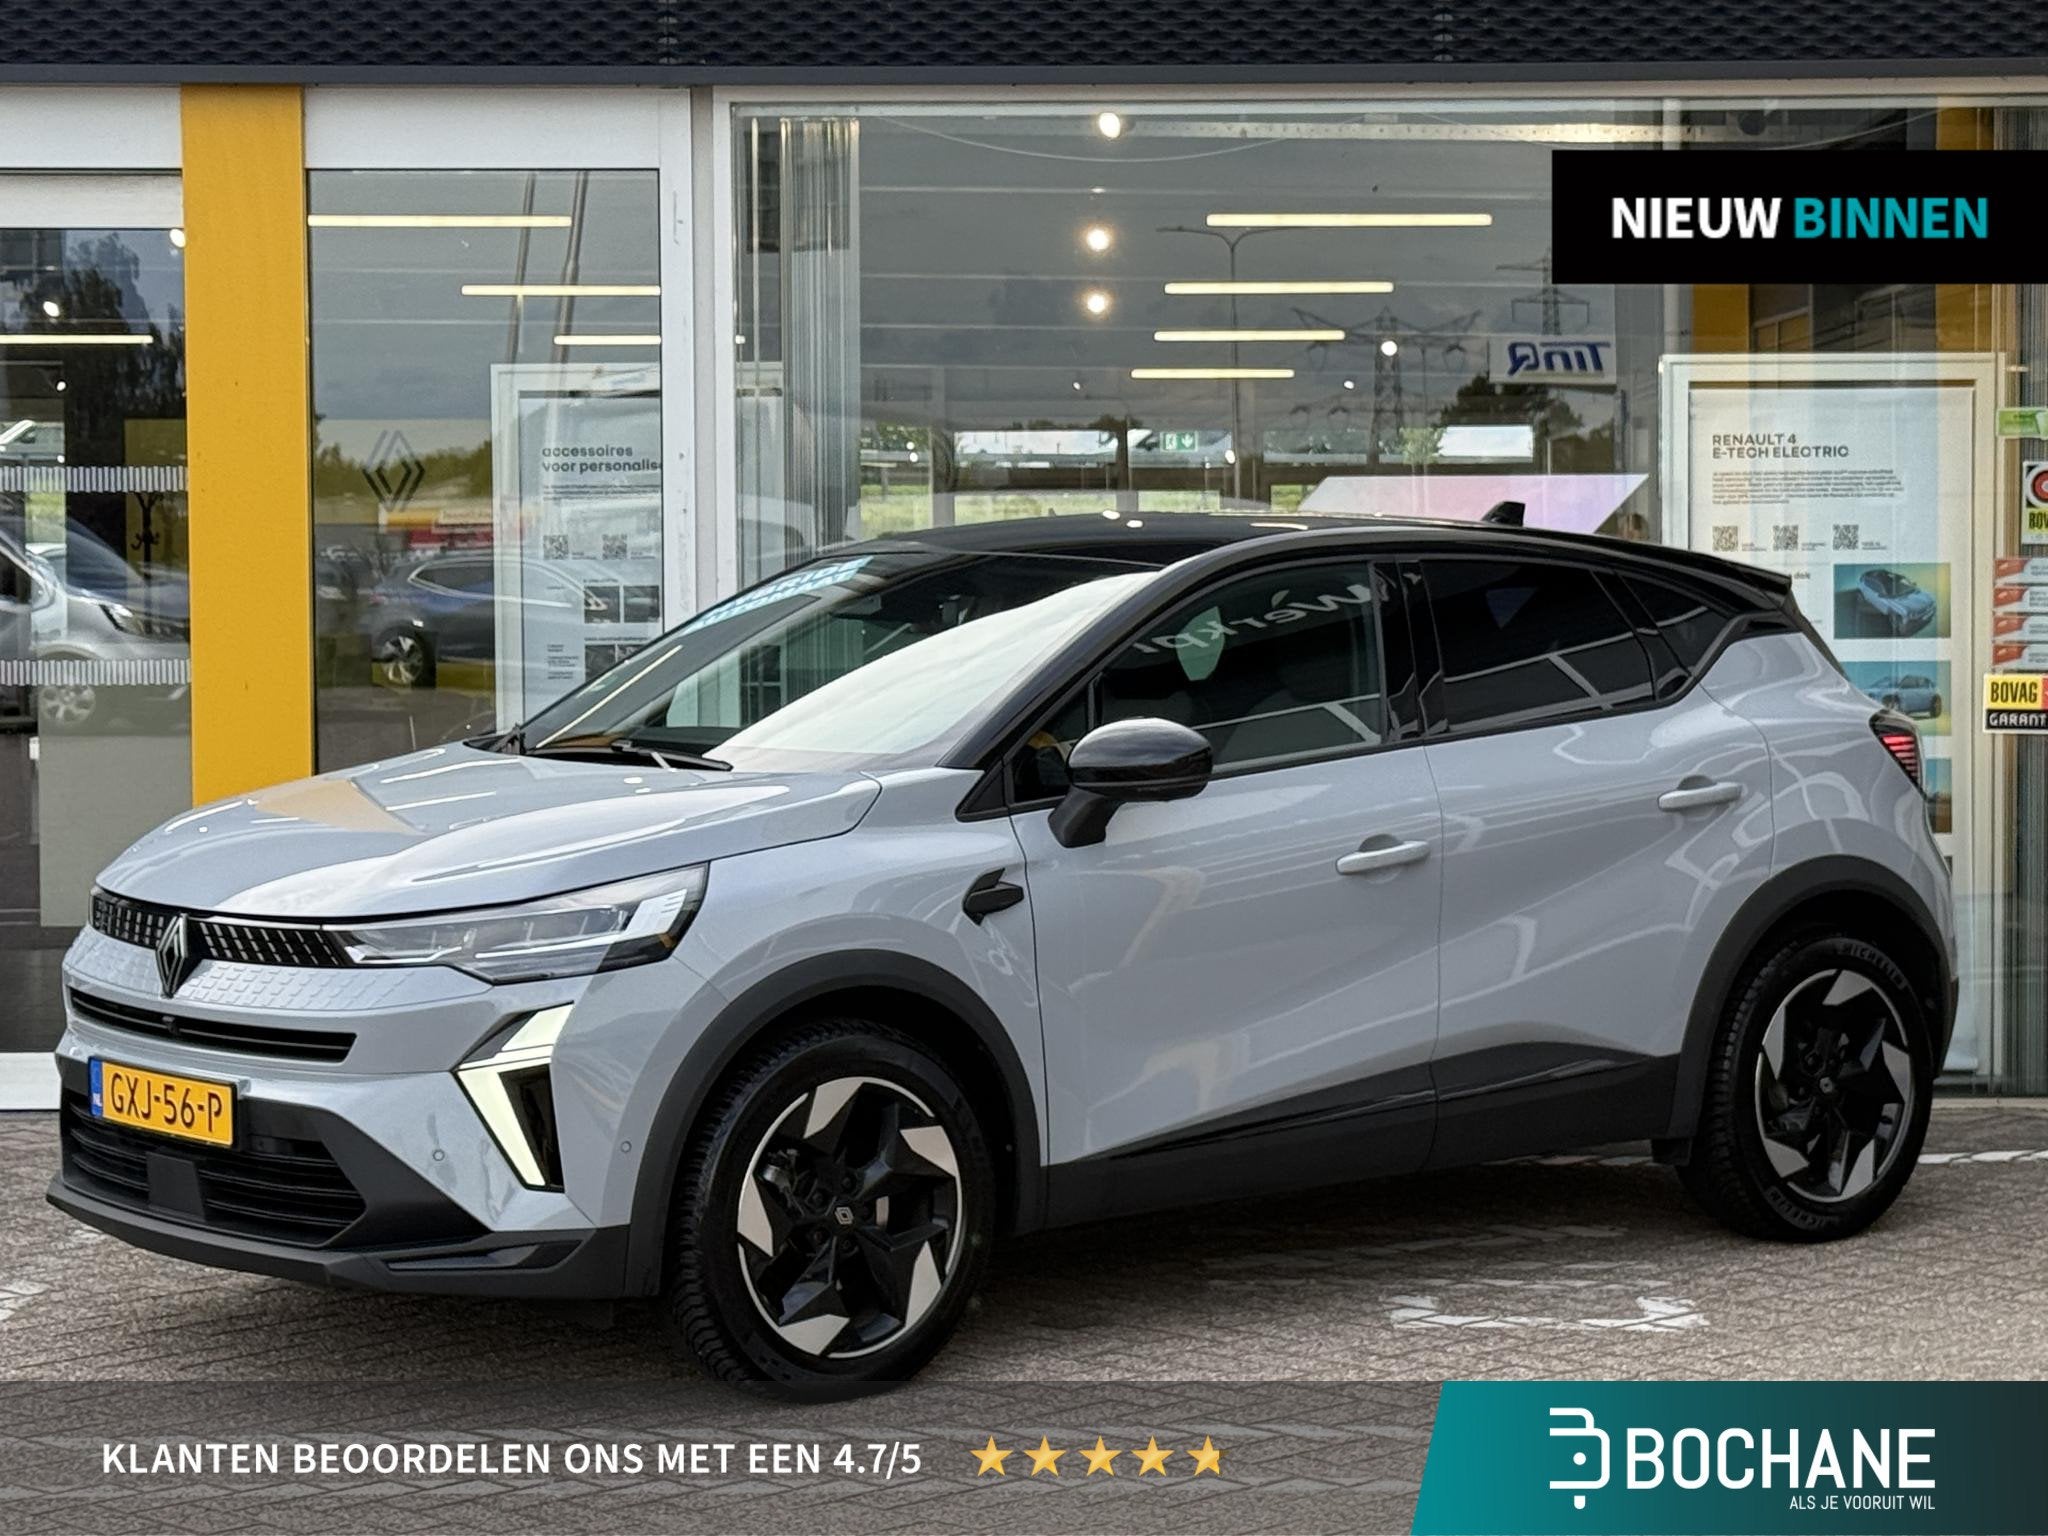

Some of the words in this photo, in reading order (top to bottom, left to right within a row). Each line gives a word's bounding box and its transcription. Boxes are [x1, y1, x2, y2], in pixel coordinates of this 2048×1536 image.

[1712, 434, 1784, 446] RENAULT
[1787, 433, 1797, 445] 4
[541, 444, 634, 458] accessoires
[1712, 447, 1770, 459] E-TECH
[1772, 445, 1850, 459] ELECTRIC
[542, 462, 577, 473] voor
[579, 458, 662, 475] personalis
[1990, 681, 2038, 703] BOVAG
[1989, 712, 2047, 727] GARANT
[110, 1072, 223, 1133] GXJ-56-P
